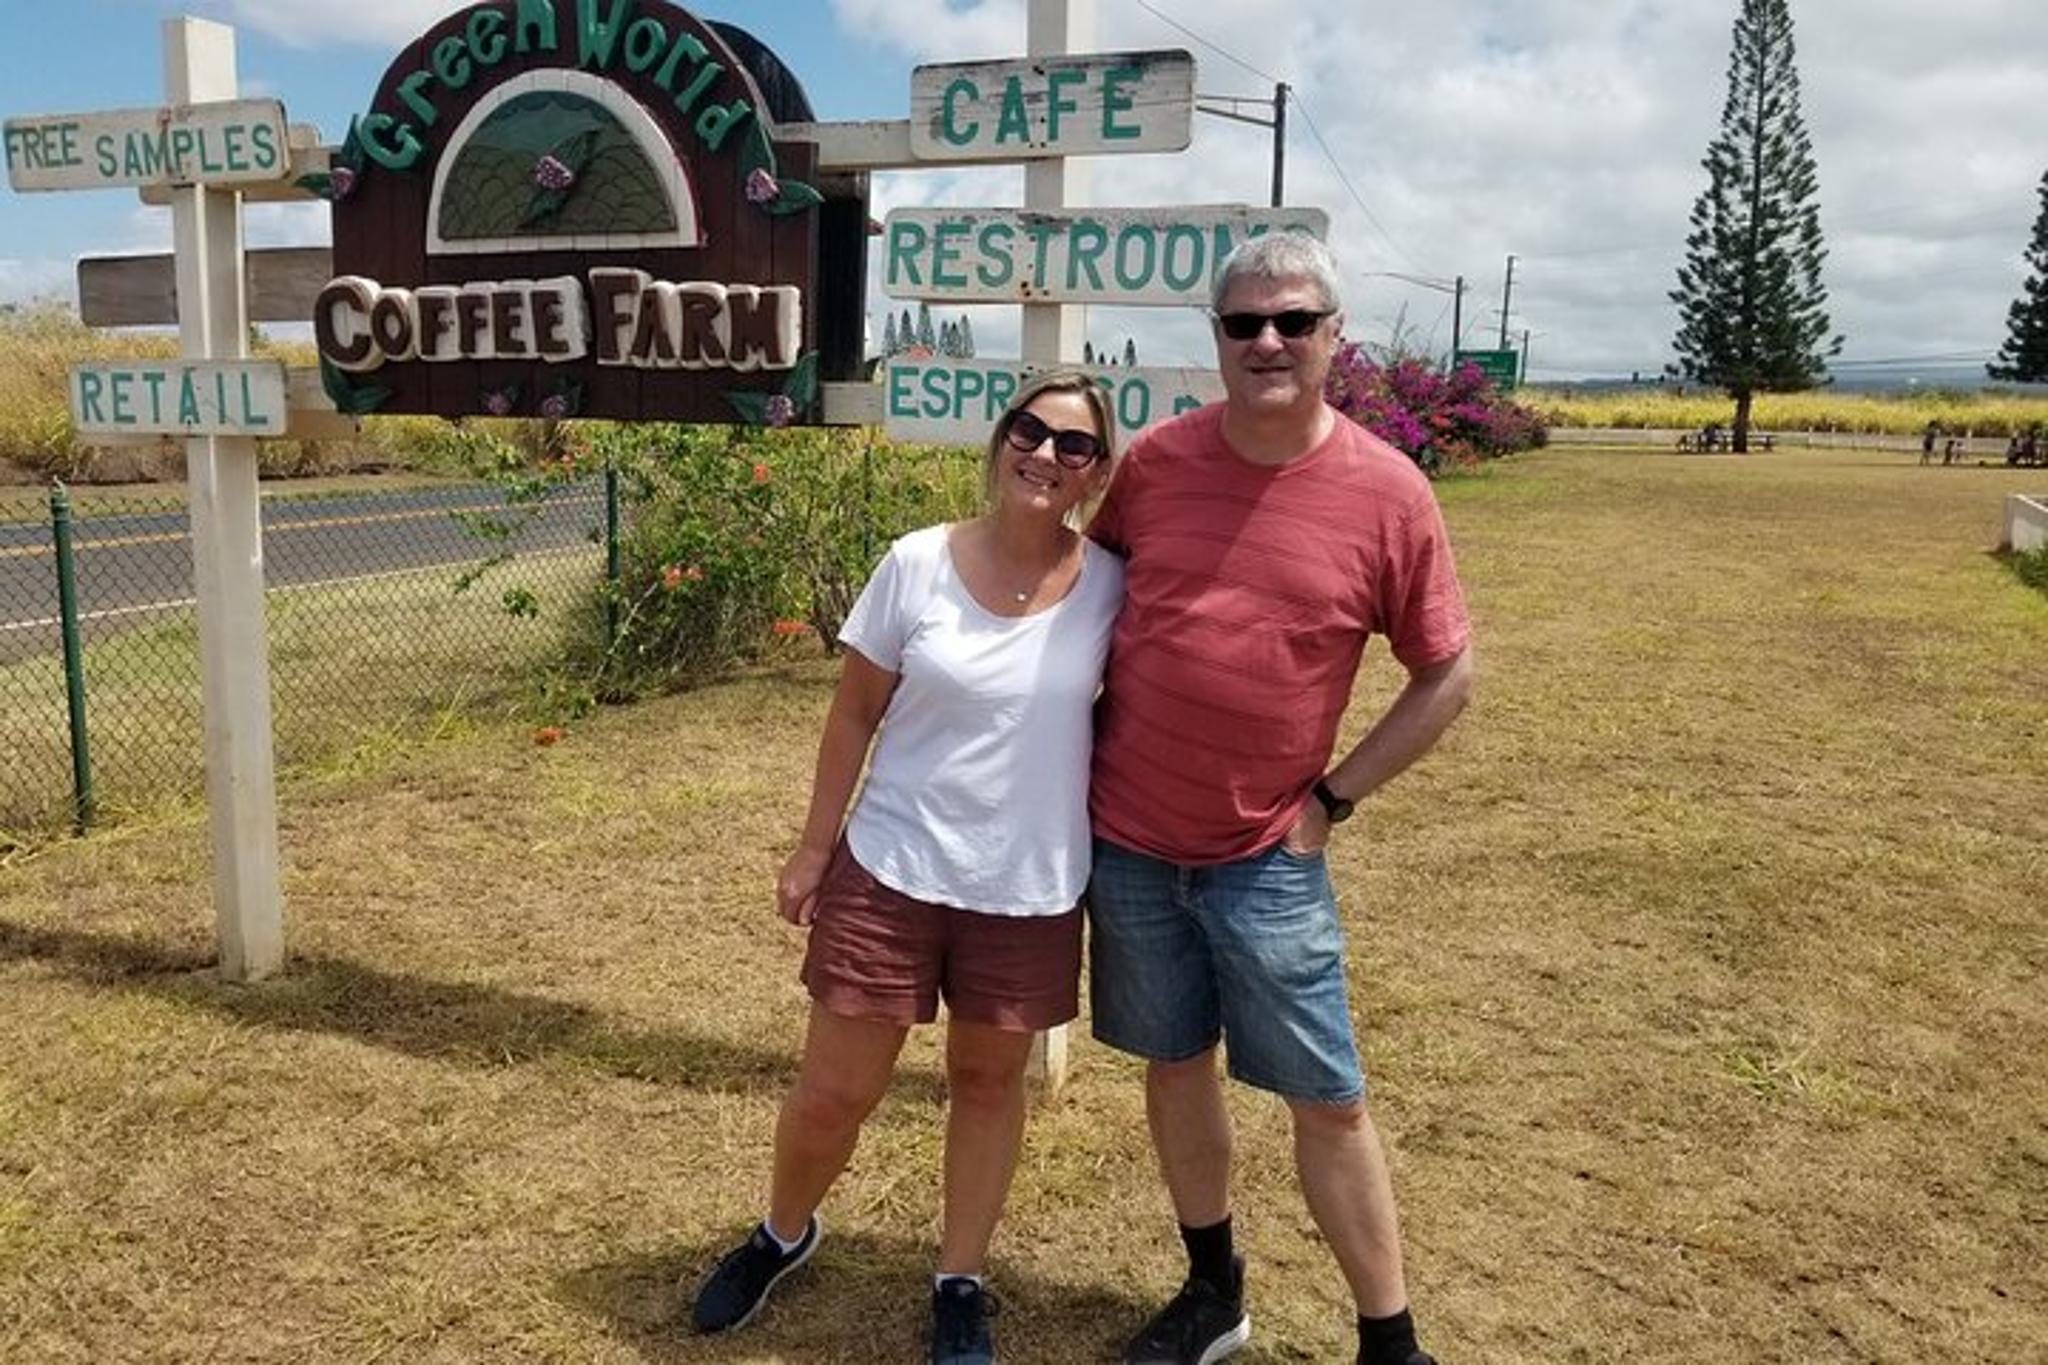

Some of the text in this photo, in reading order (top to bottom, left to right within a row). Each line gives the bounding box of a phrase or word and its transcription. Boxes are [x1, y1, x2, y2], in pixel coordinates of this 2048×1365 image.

[355, 0, 752, 170] Green World
[942, 67, 1144, 146] CAFE
[4, 122, 277, 178] FREE SAMPLES
[887, 221, 1316, 291] RESTROO
[314, 269, 797, 370] COFFEE FARM
[79, 371, 269, 425] RETAIL
[889, 366, 1151, 431] ESPRO
